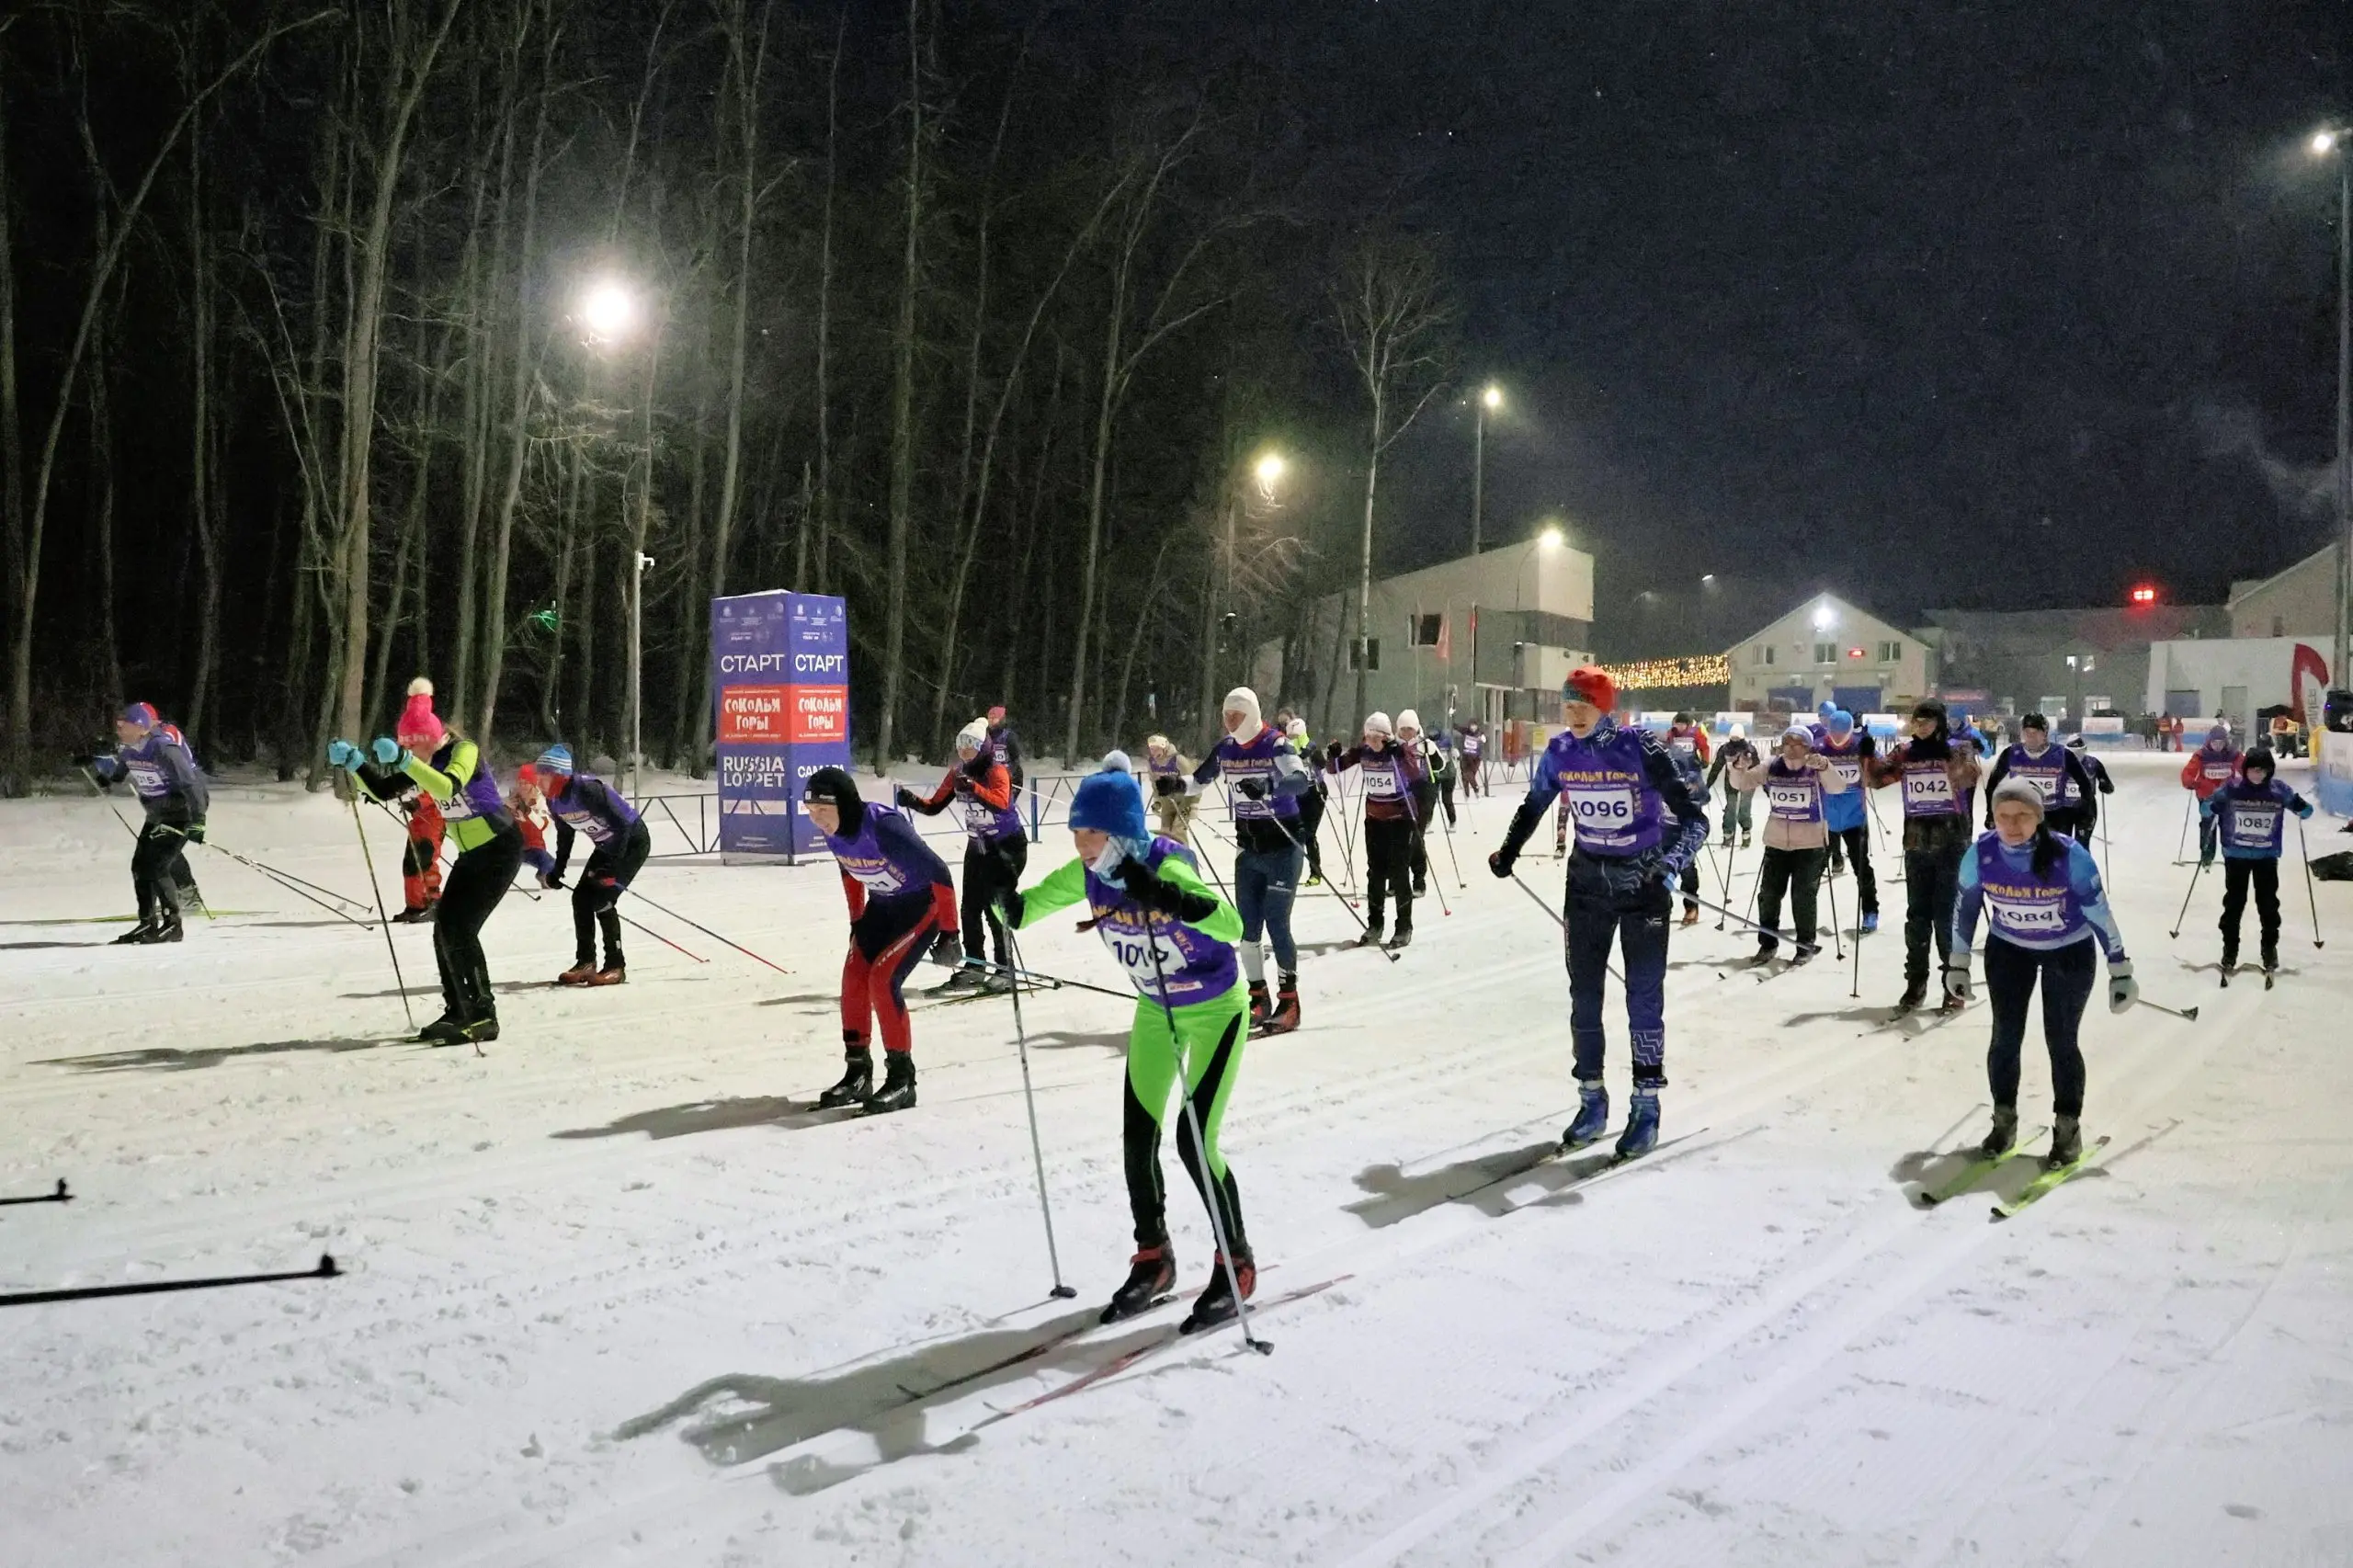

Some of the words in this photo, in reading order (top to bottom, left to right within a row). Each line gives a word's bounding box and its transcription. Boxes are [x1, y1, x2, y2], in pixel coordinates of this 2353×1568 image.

[721, 653, 785, 673] СТАРТ
[795, 653, 844, 673] СТАРТ
[735, 715, 769, 731] ГОРЫ
[808, 714, 834, 730] ГОРЫ
[723, 756, 785, 772] RUSSIA
[723, 772, 785, 788] LOPPET
[1366, 777, 1392, 788] 1054
[1909, 780, 1948, 793] 1042
[1772, 791, 1805, 802] 1051
[1572, 801, 1628, 817] 1096
[2238, 817, 2271, 828] 1082
